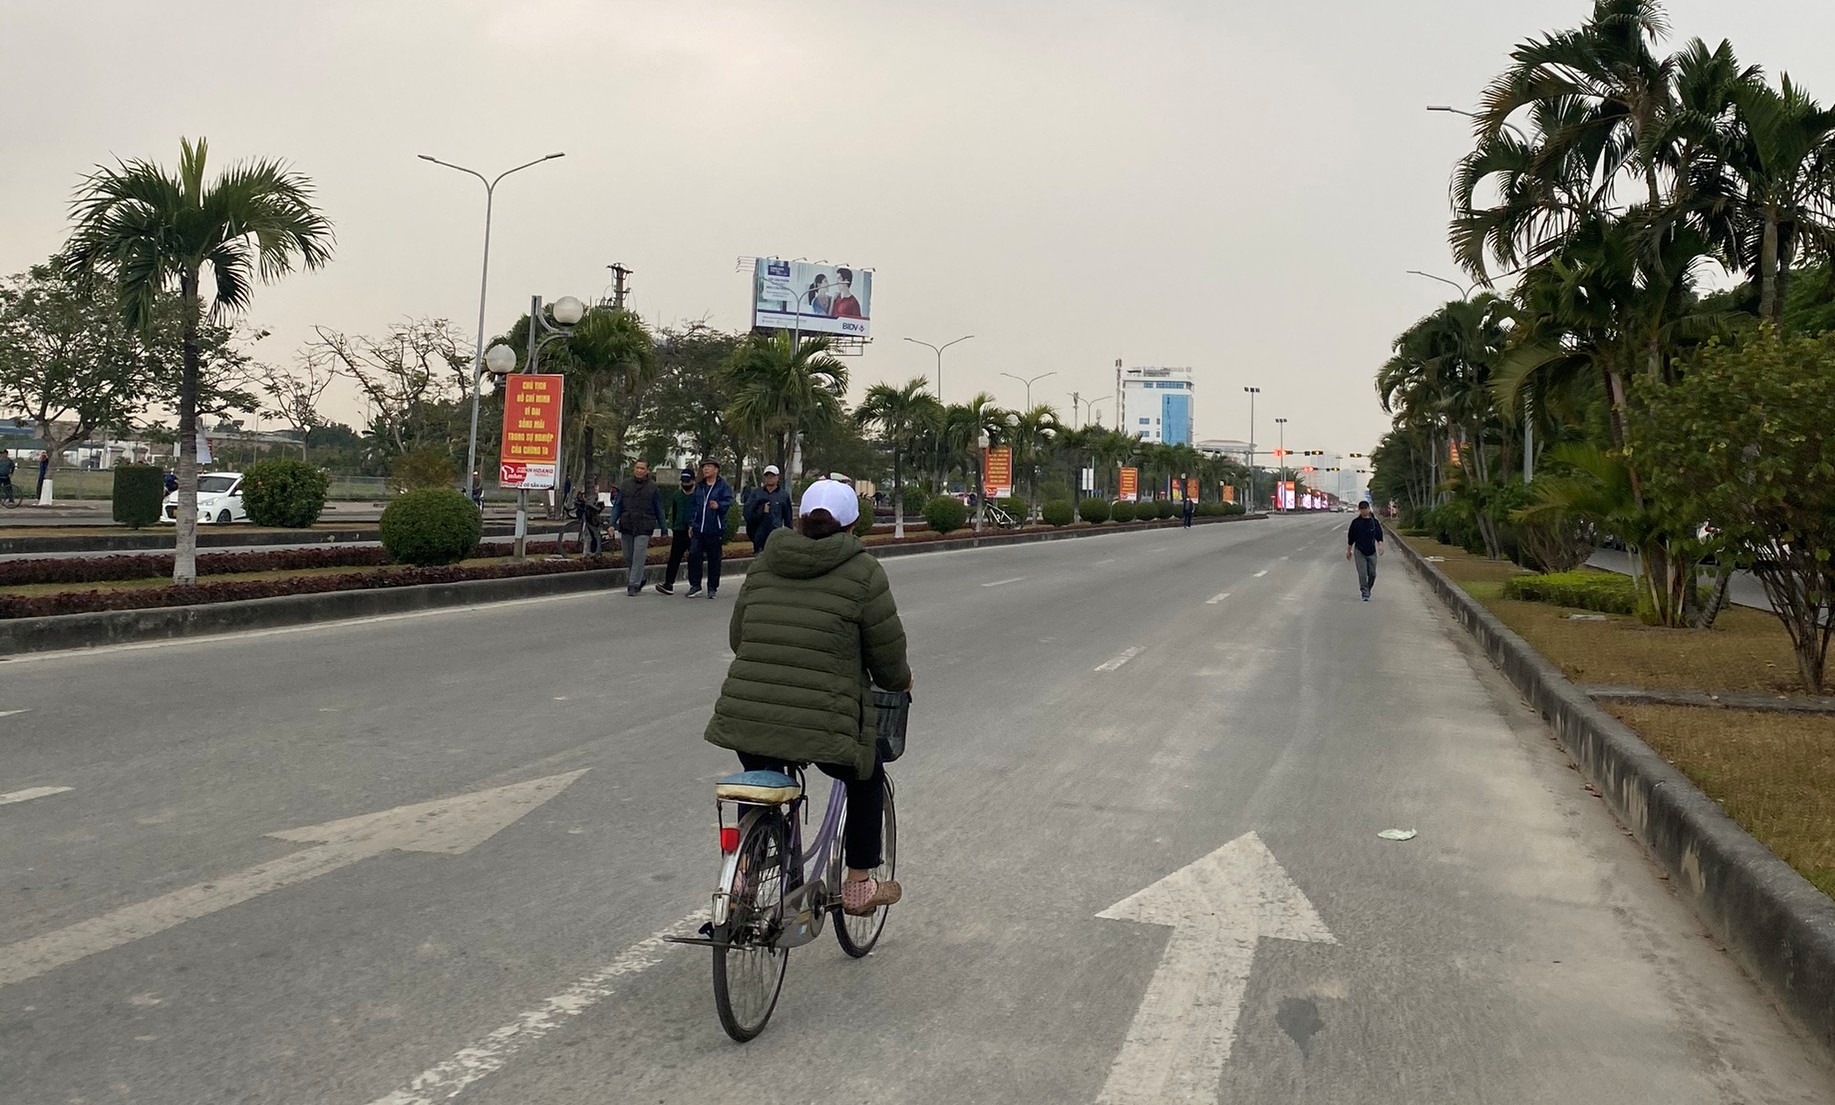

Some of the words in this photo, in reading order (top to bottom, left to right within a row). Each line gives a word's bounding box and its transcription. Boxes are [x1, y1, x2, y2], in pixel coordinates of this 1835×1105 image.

[842, 322, 858, 331] BIDV
[516, 392, 524, 402] HỒ
[525, 393, 535, 403] CHÍ
[536, 394, 550, 403] MINH
[508, 432, 525, 440] TRONG
[535, 433, 554, 443] NGHIỆP
[542, 446, 548, 455] TA
